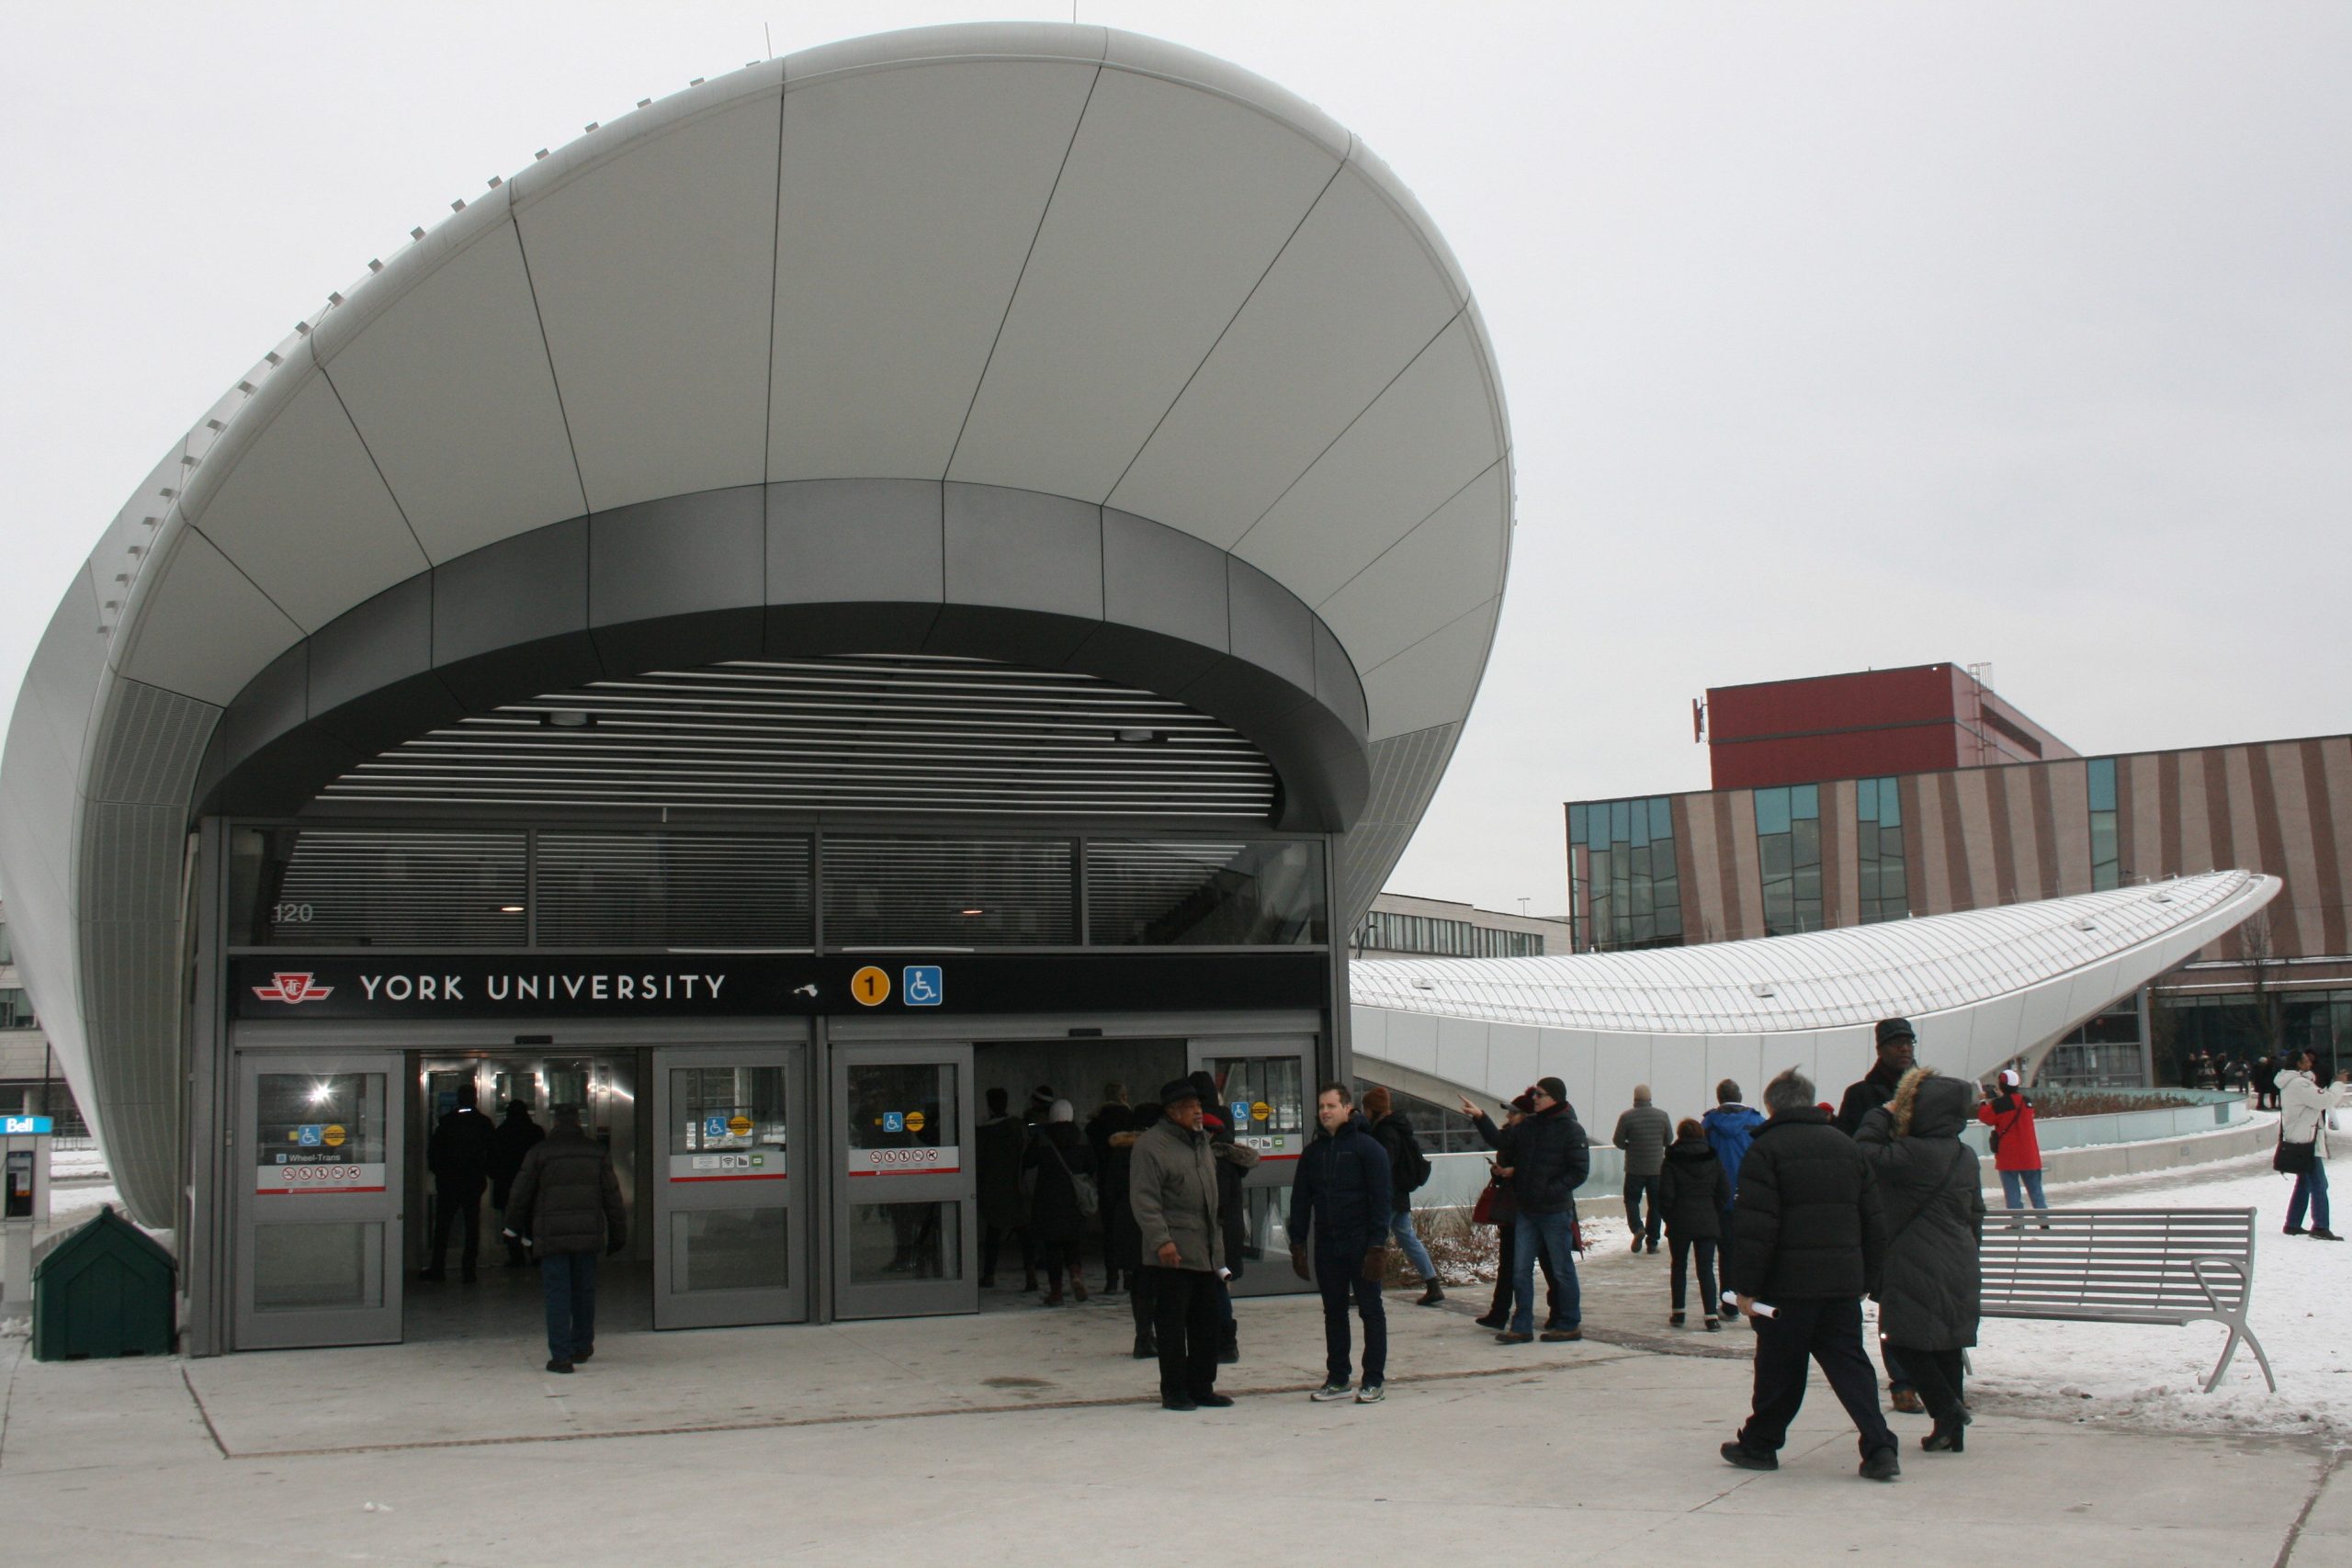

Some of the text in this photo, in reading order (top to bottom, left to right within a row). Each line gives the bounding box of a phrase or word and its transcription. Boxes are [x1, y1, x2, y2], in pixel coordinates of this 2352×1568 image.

[274, 904, 312, 922] 120
[360, 975, 726, 1000] YORK UNIVERSITY
[865, 976, 874, 997] 1
[6, 1118, 33, 1133] Bell
